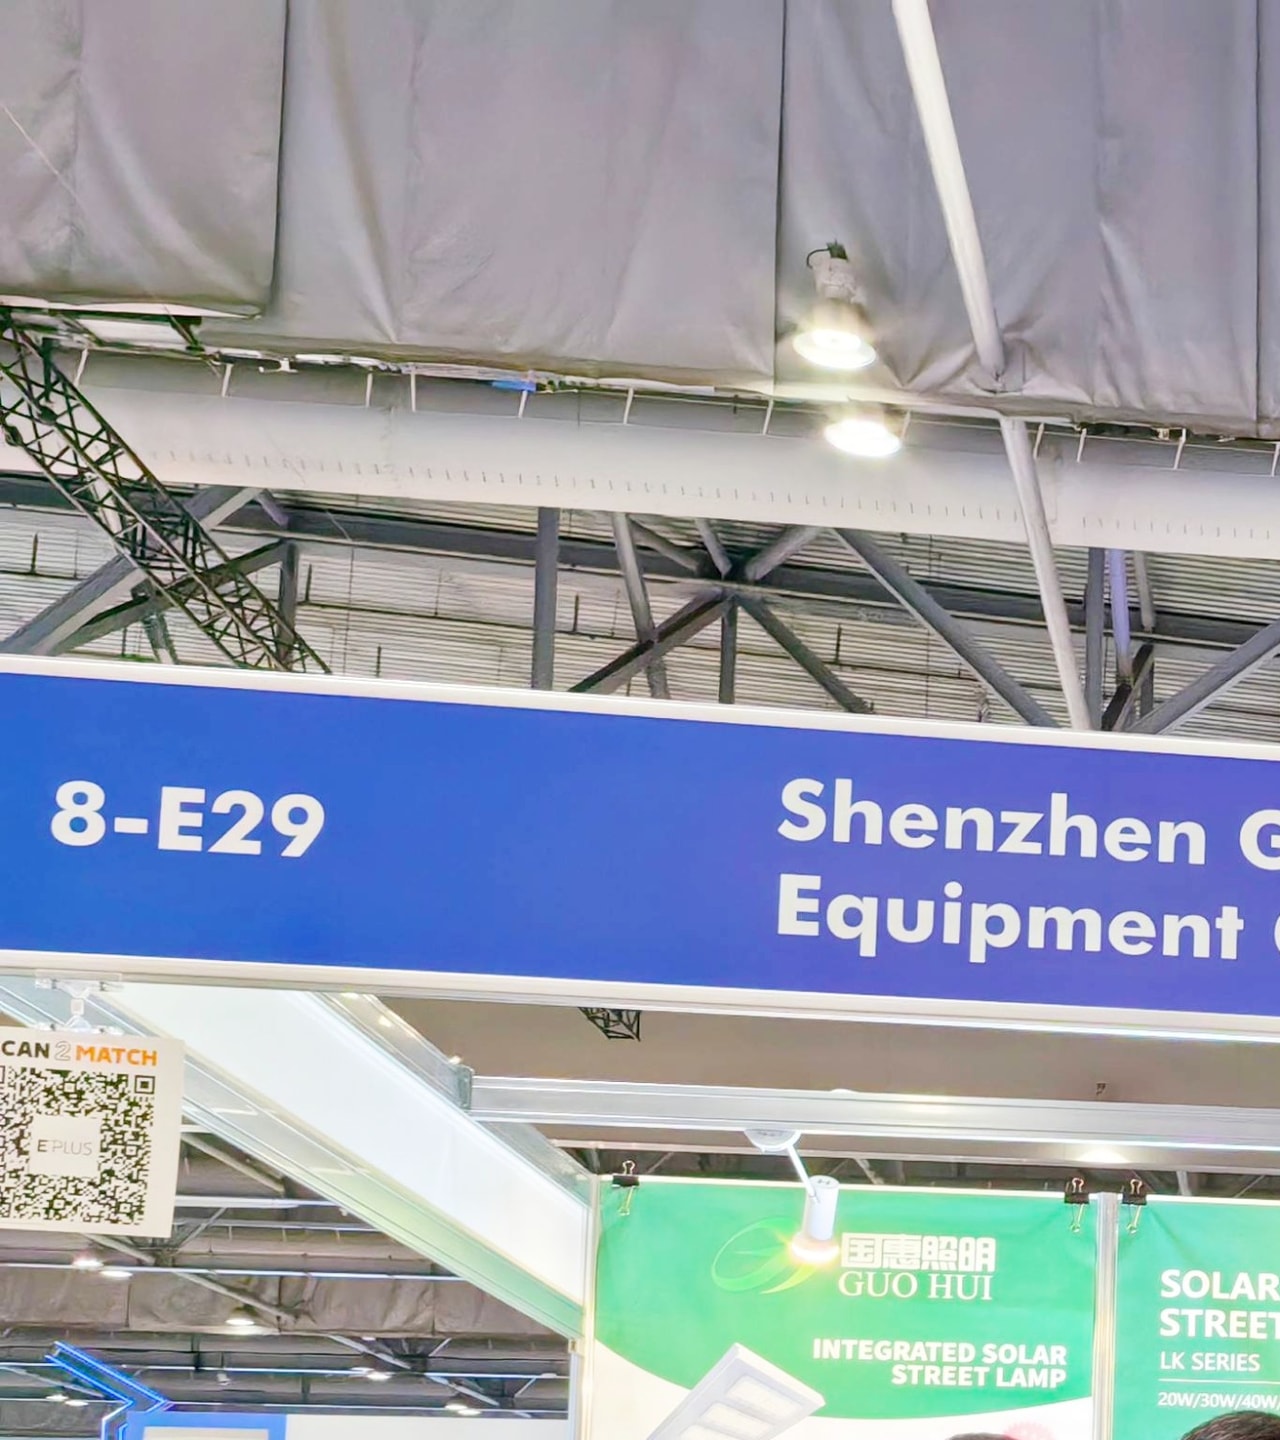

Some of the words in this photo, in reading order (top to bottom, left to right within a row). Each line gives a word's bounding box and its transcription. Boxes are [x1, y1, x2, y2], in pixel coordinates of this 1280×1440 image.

[50, 780, 325, 858] 8-E29
[777, 778, 1206, 865] Shenzhen
[777, 874, 1244, 963] Equipment
[55, 1041, 71, 1061] 2
[75, 1045, 157, 1066] MATCH
[840, 1231, 997, 1273] 国惠照明
[838, 1271, 918, 1299] GUO
[927, 1273, 993, 1301] HUI
[1160, 1268, 1280, 1302] SOLAR
[812, 1337, 975, 1365] INTEGRATED
[981, 1343, 1067, 1366] SOLAR
[1159, 1350, 1185, 1370] LK
[1191, 1353, 1260, 1372] SERIES
[891, 1363, 990, 1387] STREET
[996, 1366, 1067, 1389] LAMP
